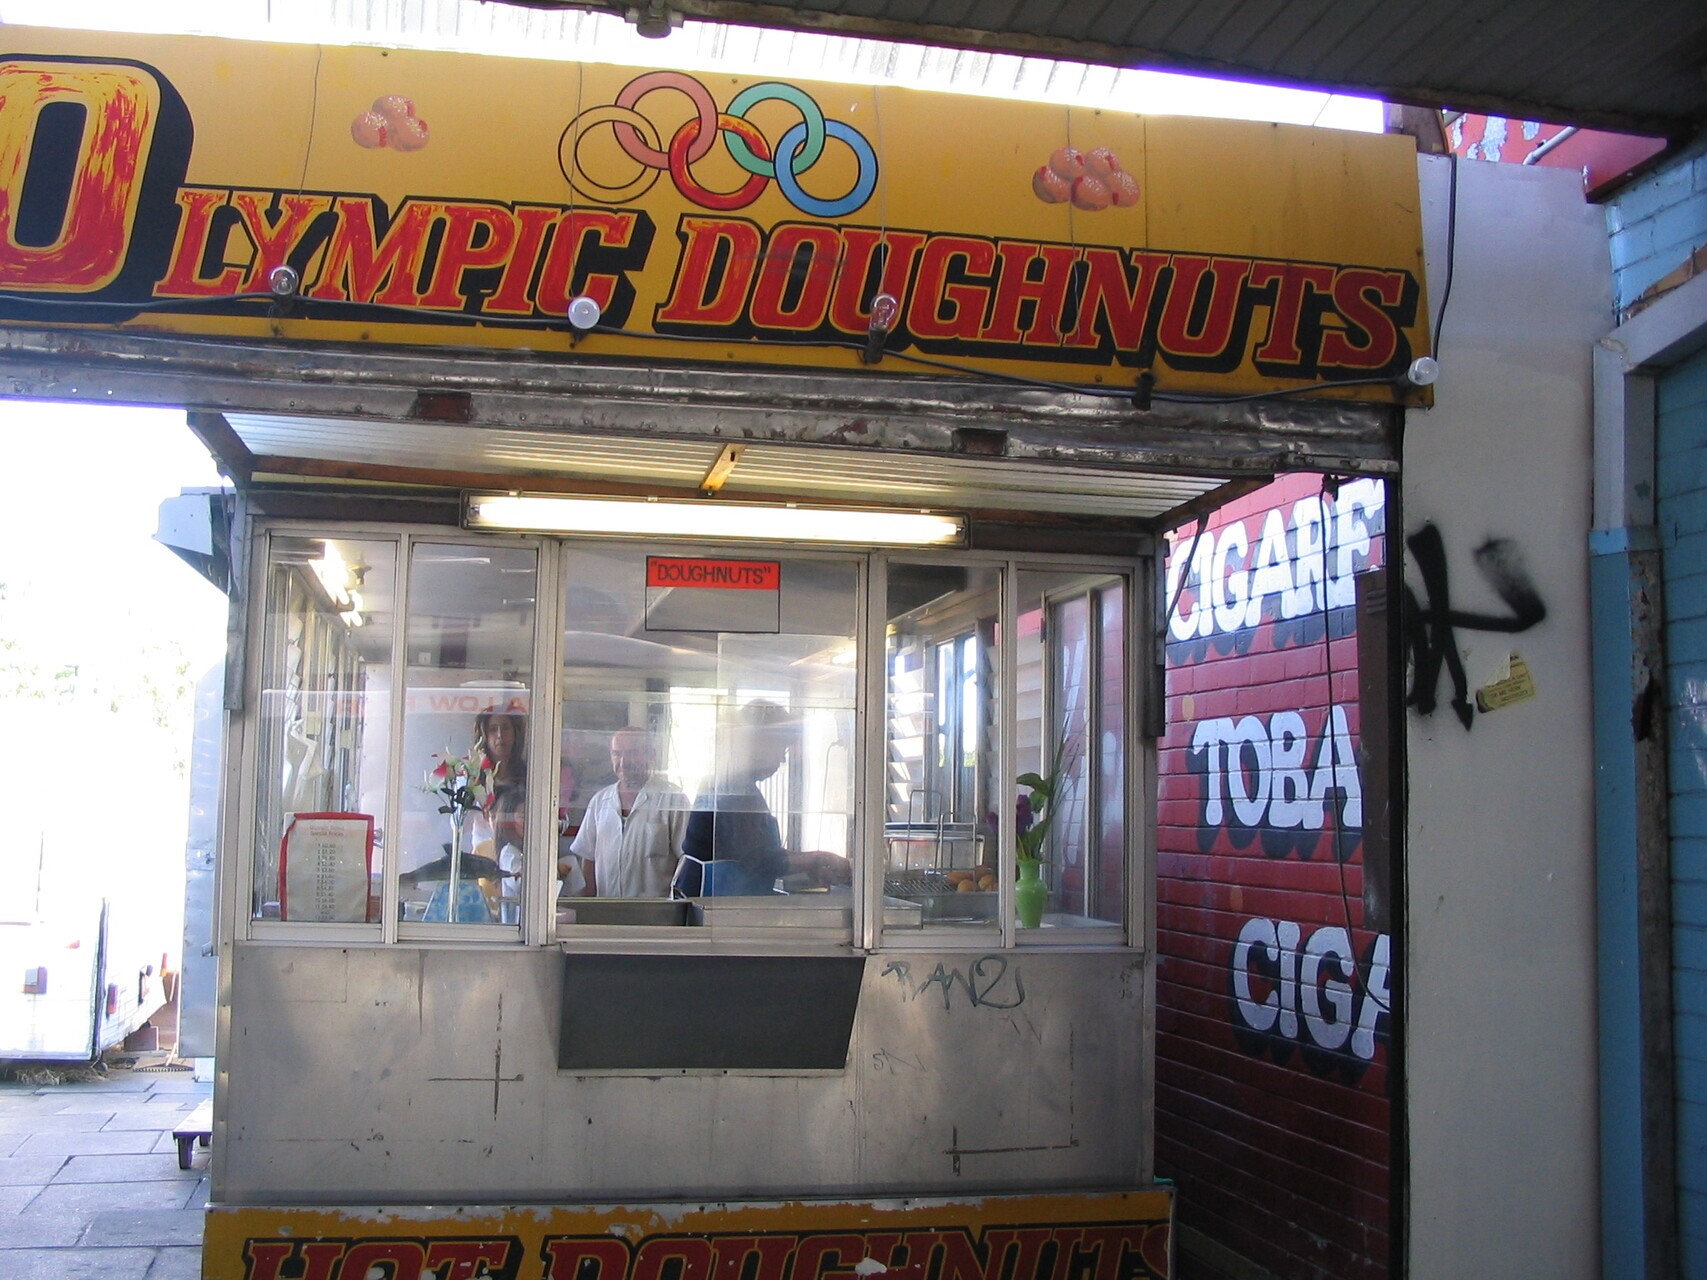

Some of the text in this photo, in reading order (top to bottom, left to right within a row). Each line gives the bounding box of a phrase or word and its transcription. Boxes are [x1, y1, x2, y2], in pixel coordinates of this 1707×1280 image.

[0, 56, 1416, 370] OLYMPIC DOUGHNUTS
[1192, 704, 1362, 829] TOBA
